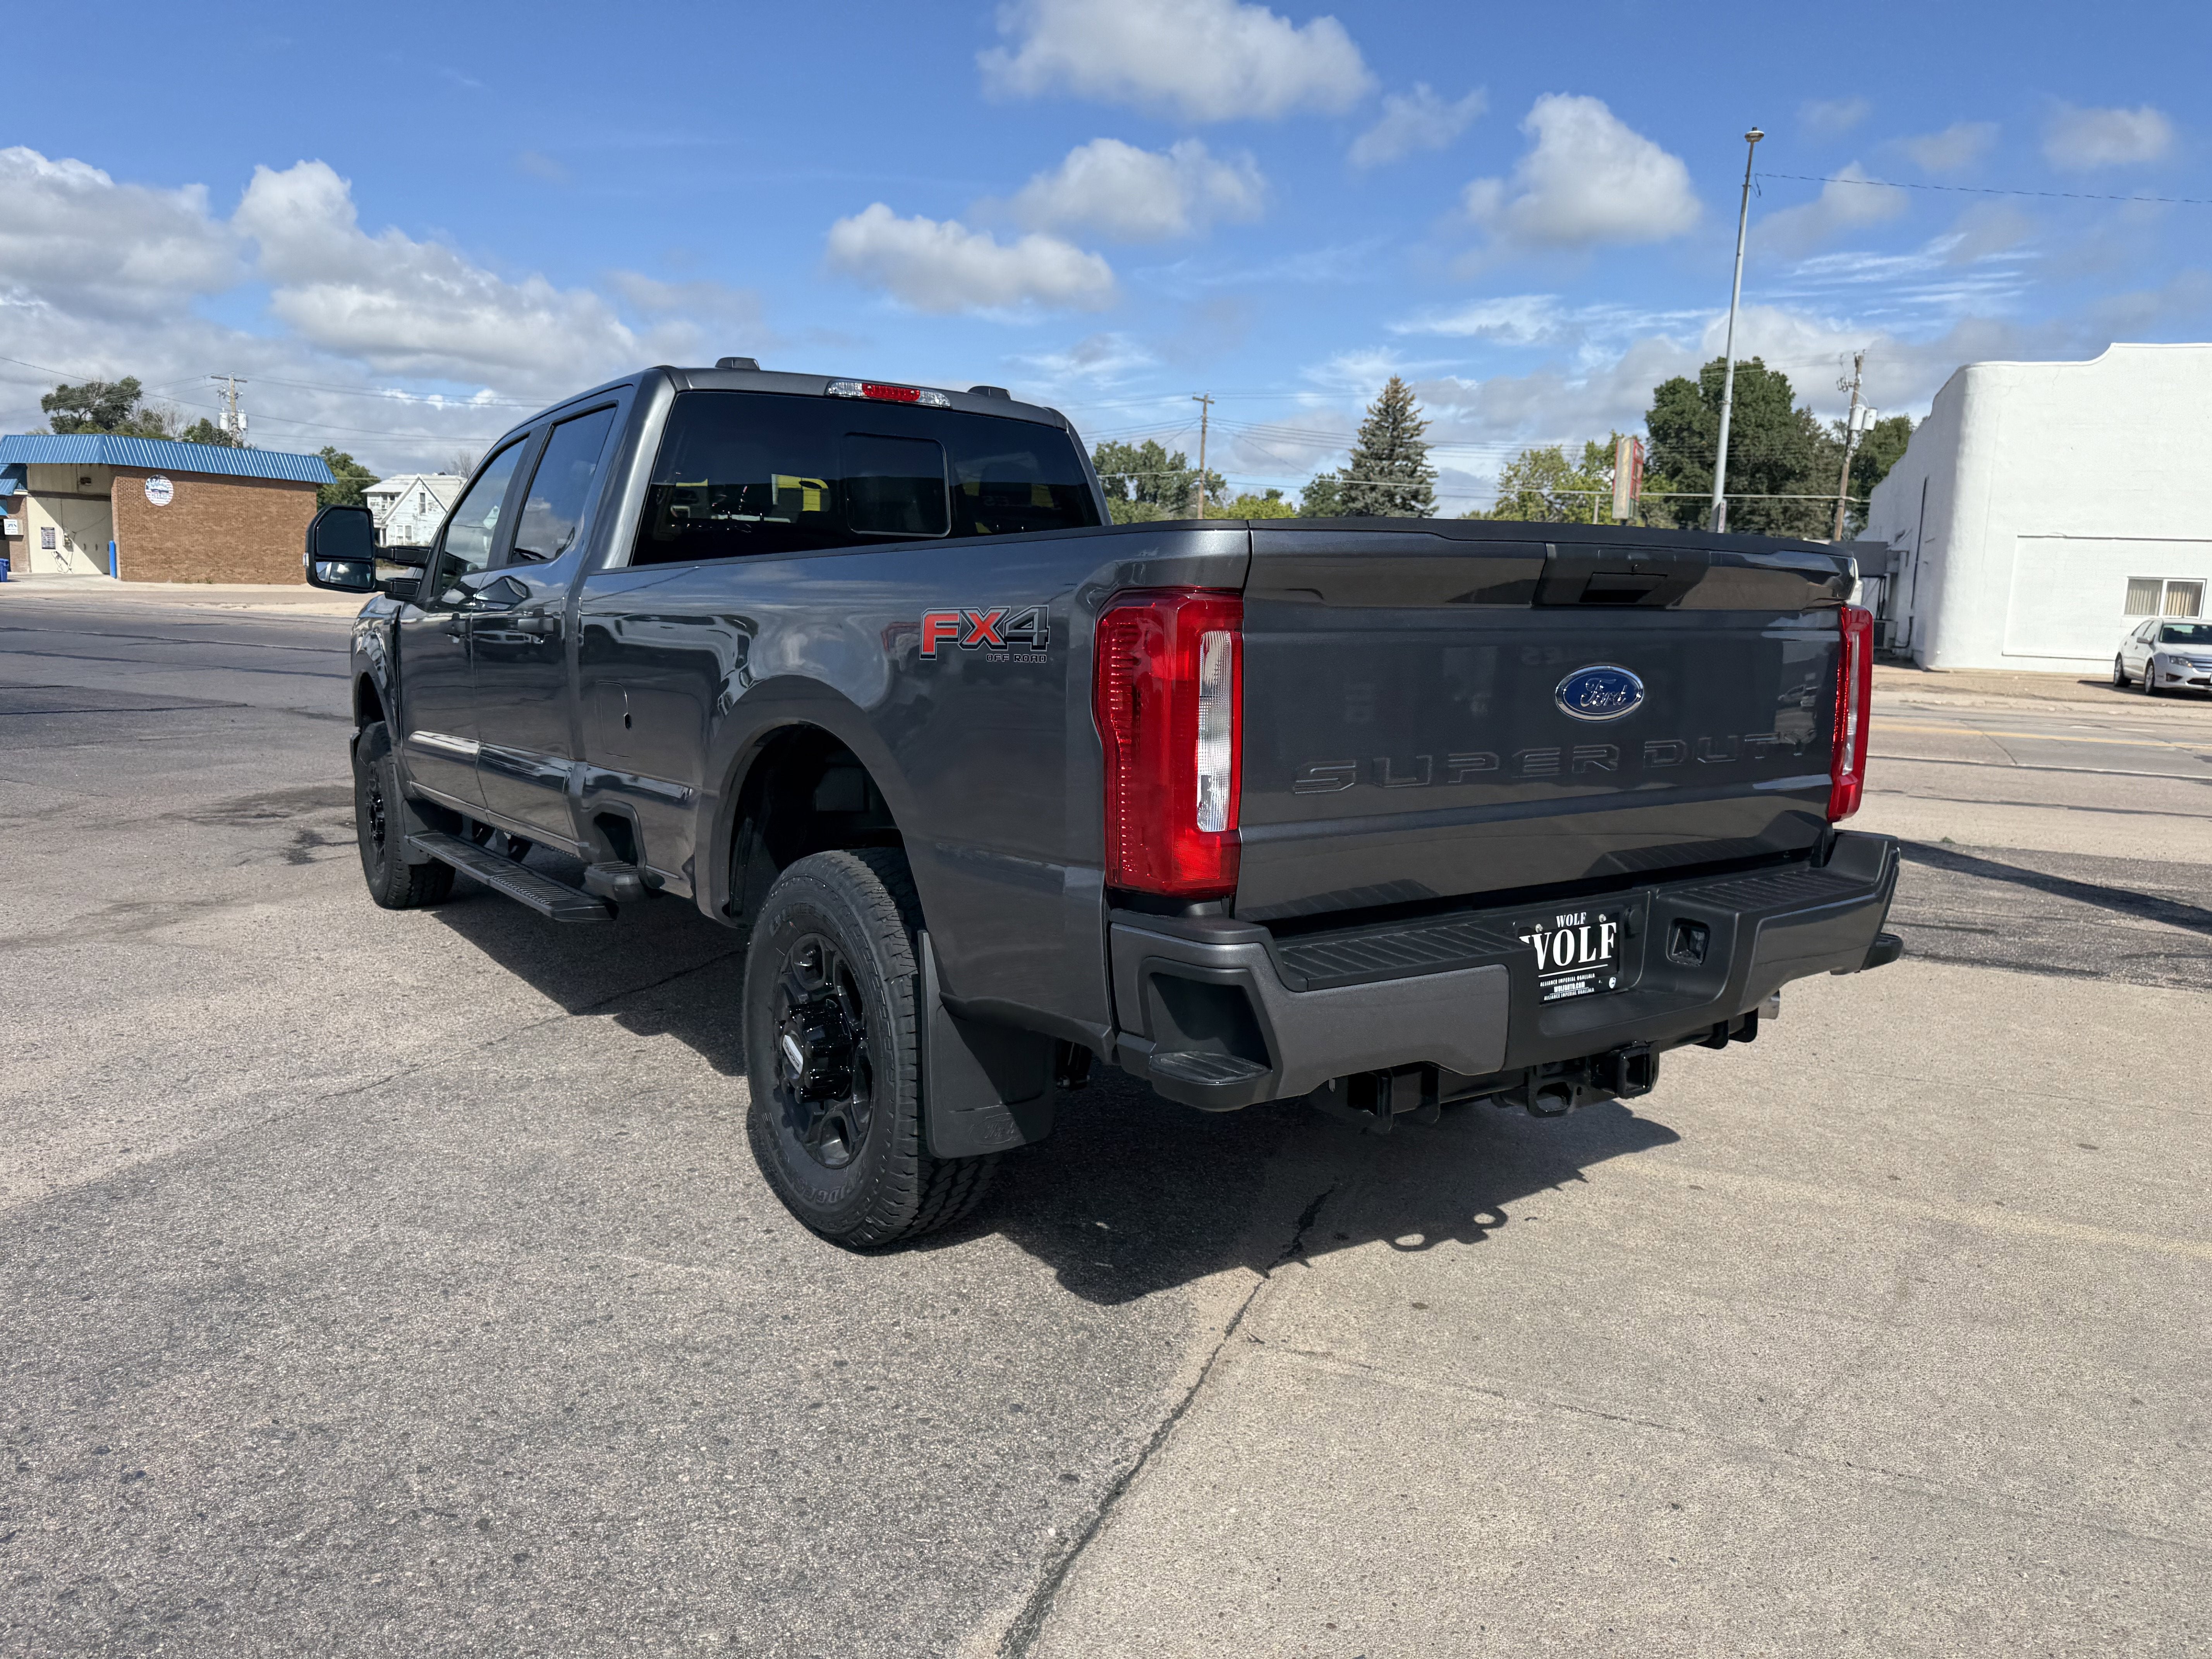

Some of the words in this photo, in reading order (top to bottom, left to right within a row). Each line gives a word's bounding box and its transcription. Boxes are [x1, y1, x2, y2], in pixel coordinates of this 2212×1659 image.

[919, 605, 1050, 660] FX4
[986, 653, 1010, 663] OFF
[1013, 654, 1047, 663] ROAD
[1580, 678, 1627, 707] Ford
[1292, 743, 1620, 795] SUPER
[1643, 729, 1817, 768] DUTY
[1556, 912, 1587, 928] WOLF
[1519, 922, 1616, 970] WOLF
[1554, 981, 1585, 993] WOLFAUTO.COM
